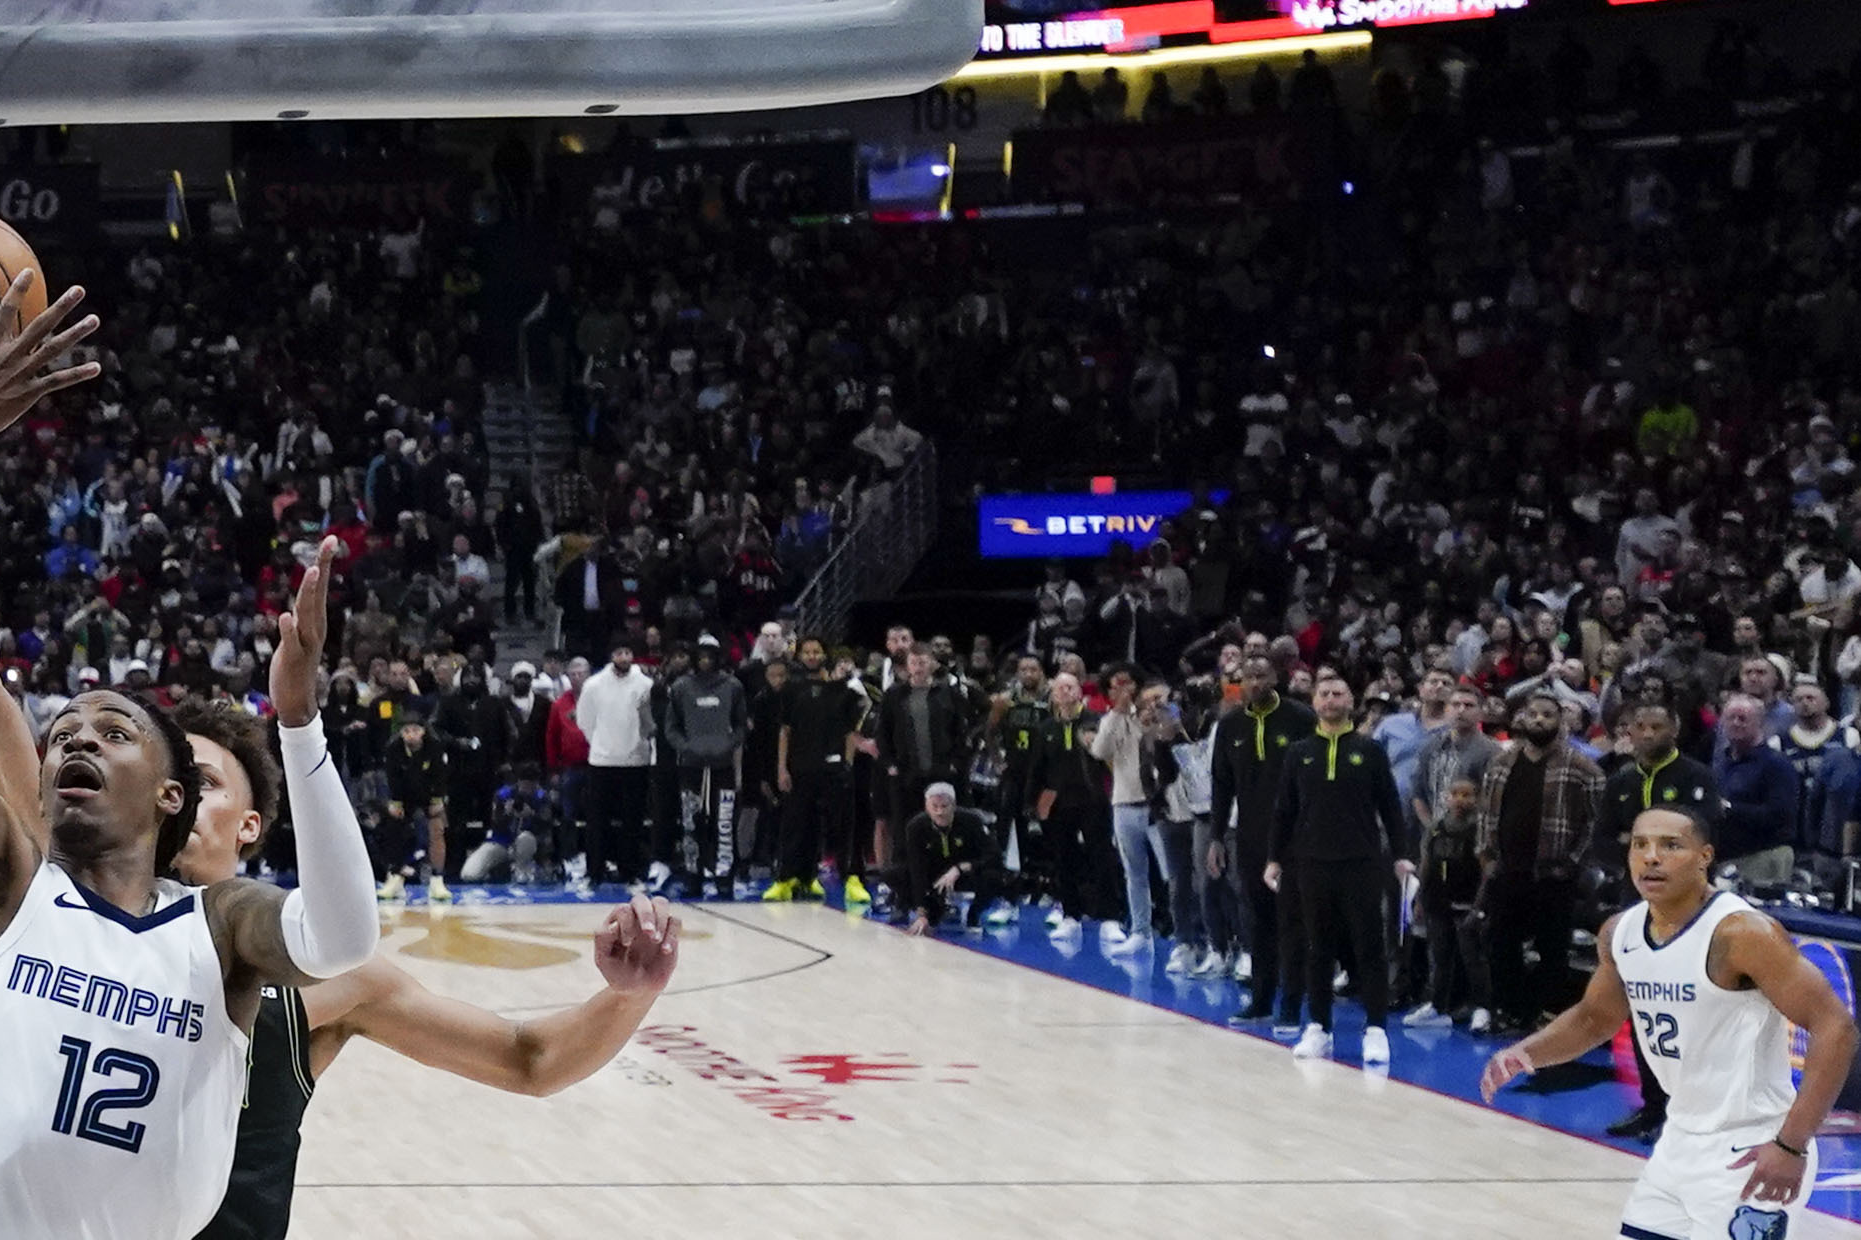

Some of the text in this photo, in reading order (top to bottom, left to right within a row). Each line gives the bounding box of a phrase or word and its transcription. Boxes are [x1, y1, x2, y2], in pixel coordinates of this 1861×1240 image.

[1046, 514, 1159, 535] BETRIV
[6, 953, 205, 1043] MEMPHS
[1625, 981, 1696, 1002] EMPHIS
[1637, 1010, 1681, 1060] 22
[51, 1034, 161, 1154] 12
